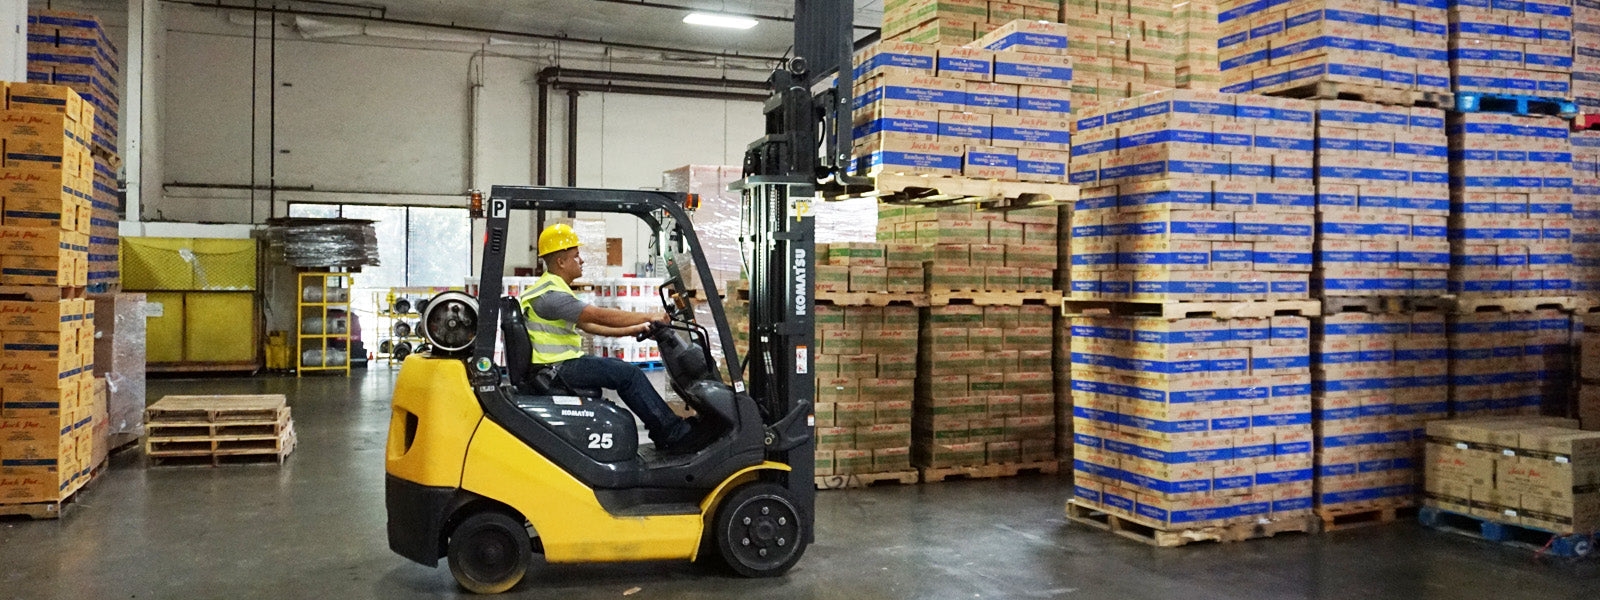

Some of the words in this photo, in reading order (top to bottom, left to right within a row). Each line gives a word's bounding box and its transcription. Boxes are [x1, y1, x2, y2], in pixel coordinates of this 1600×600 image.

[893, 43, 910, 51] Jack
[911, 44, 923, 52] Pot
[1039, 55, 1051, 63] Pot
[912, 76, 929, 84] Jack
[929, 78, 942, 86] Pot
[911, 142, 927, 150] Jack
[928, 143, 940, 151] Pot
[494, 201, 504, 216] P
[793, 249, 806, 315] KOMATSU
[588, 433, 614, 449] 25
